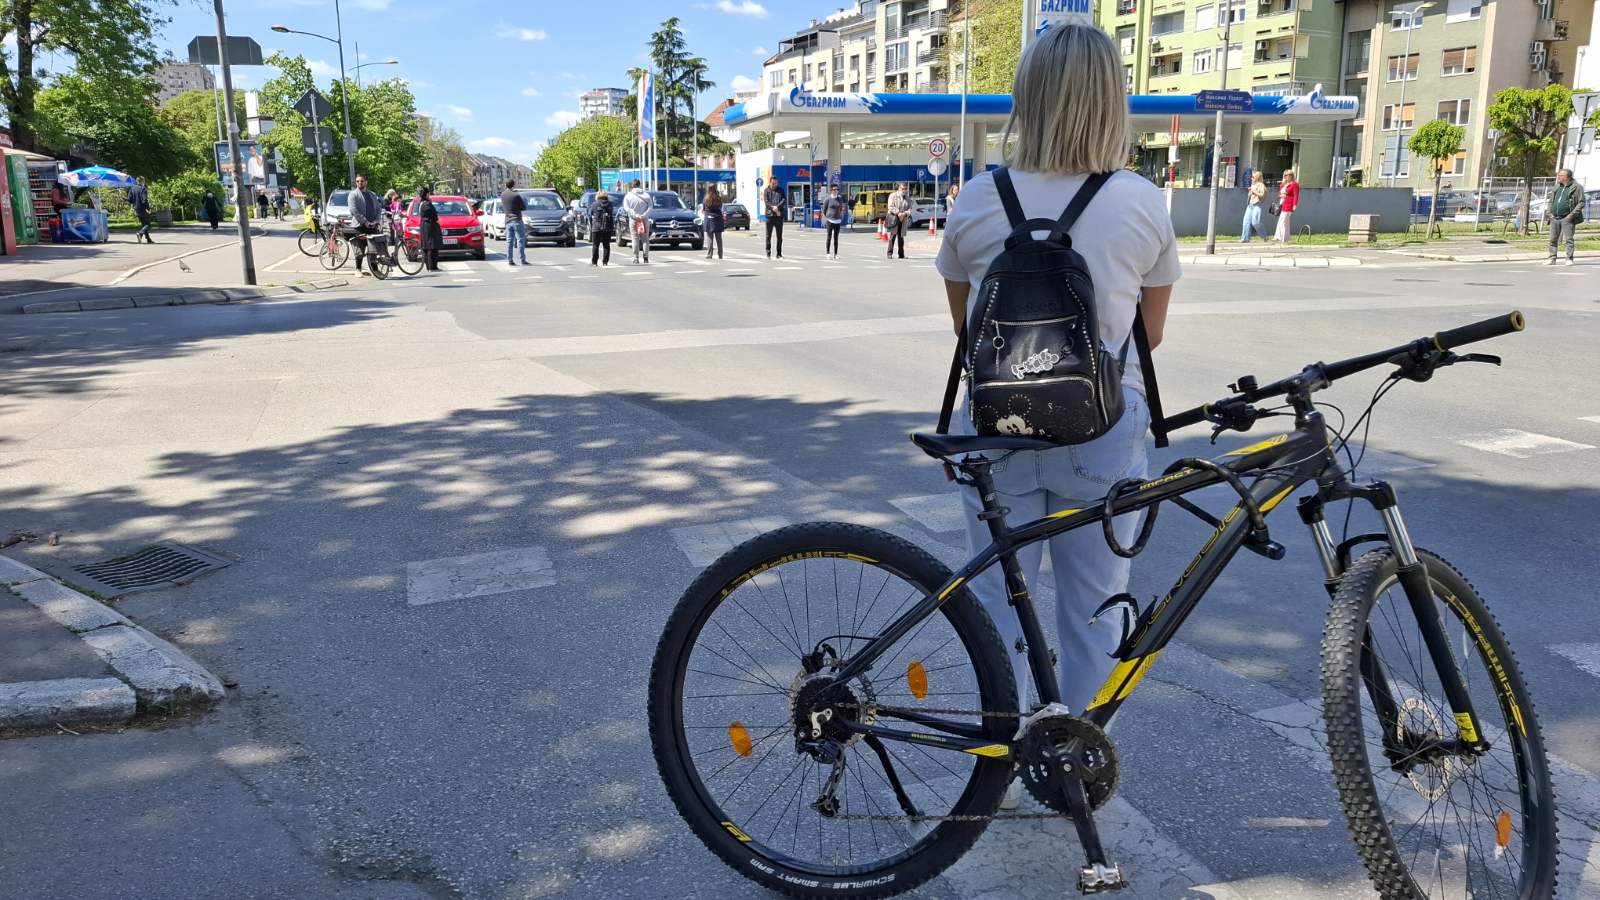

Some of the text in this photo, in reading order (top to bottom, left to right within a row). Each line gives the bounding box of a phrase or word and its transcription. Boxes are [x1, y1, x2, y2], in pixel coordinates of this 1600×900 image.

[1041, 0, 1089, 13] GAZPROM
[806, 96, 846, 108] GAZPROM
[1322, 99, 1354, 109] GAZPROM
[932, 143, 943, 153] 20
[750, 858, 896, 889] SCHWALBE SMART SAM
